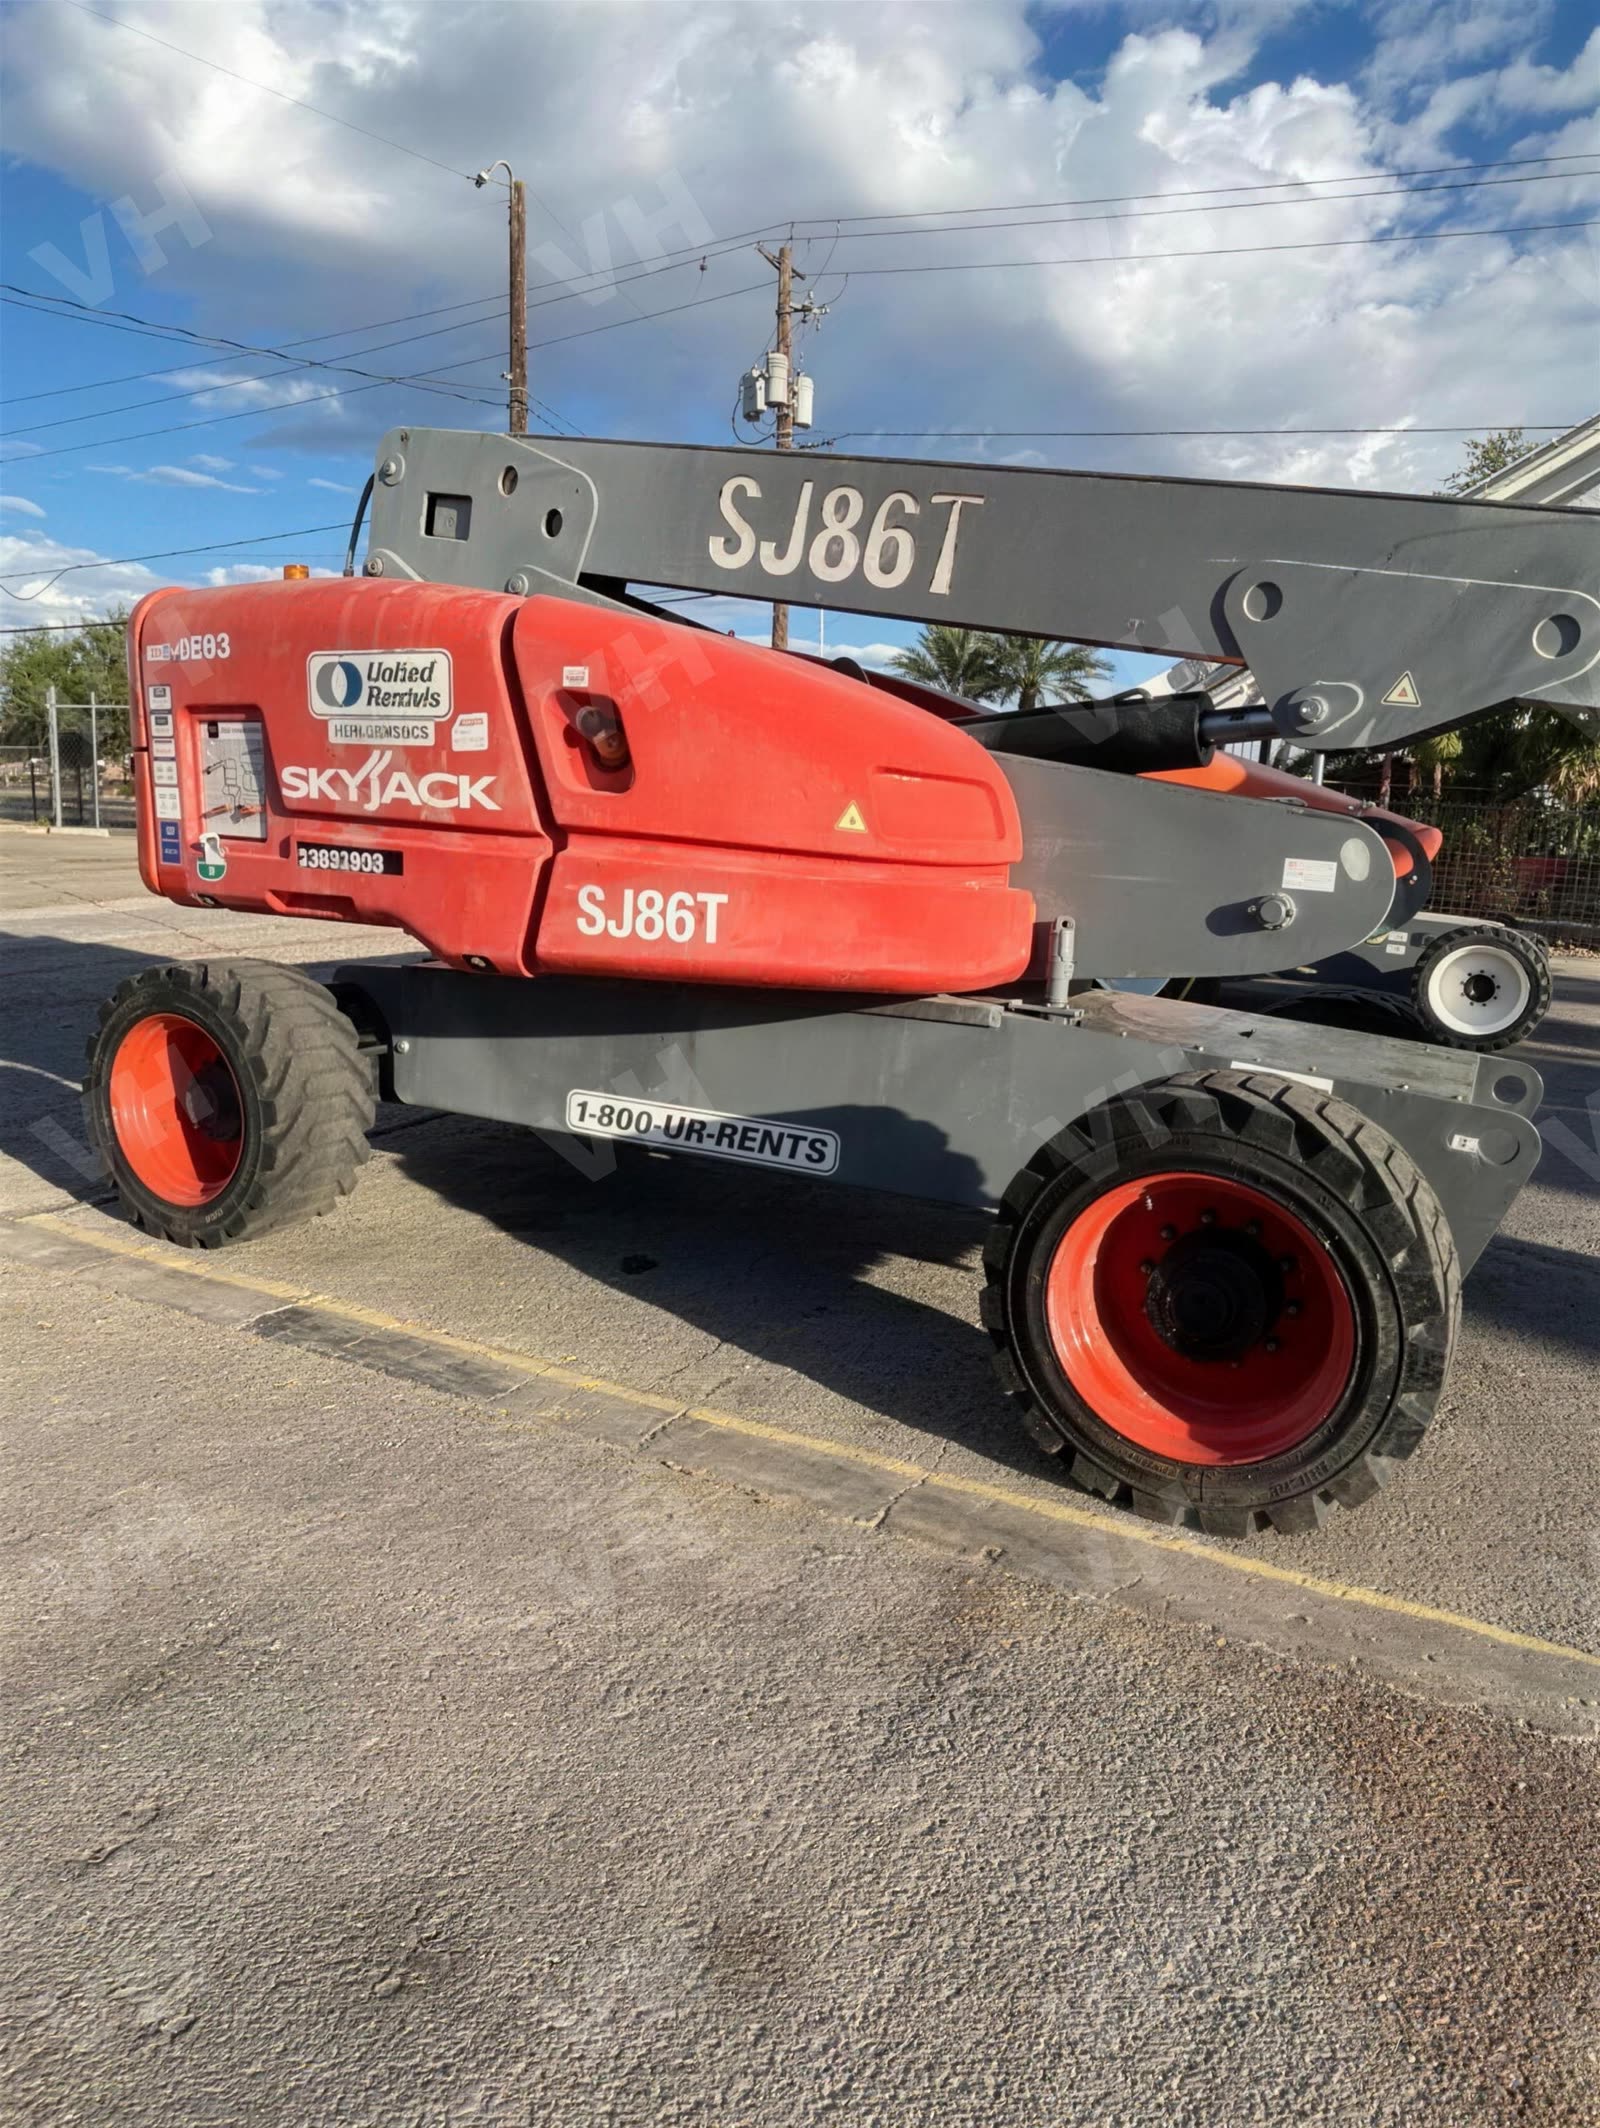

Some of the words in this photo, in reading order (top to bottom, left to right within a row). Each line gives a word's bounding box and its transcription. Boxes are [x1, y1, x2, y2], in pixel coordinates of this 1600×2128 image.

[708, 473, 985, 596] SJ86T
[281, 750, 502, 812] SKYJACK
[576, 884, 729, 944] SJ86T
[576, 1100, 829, 1165] 1-800-UR-RENTS
